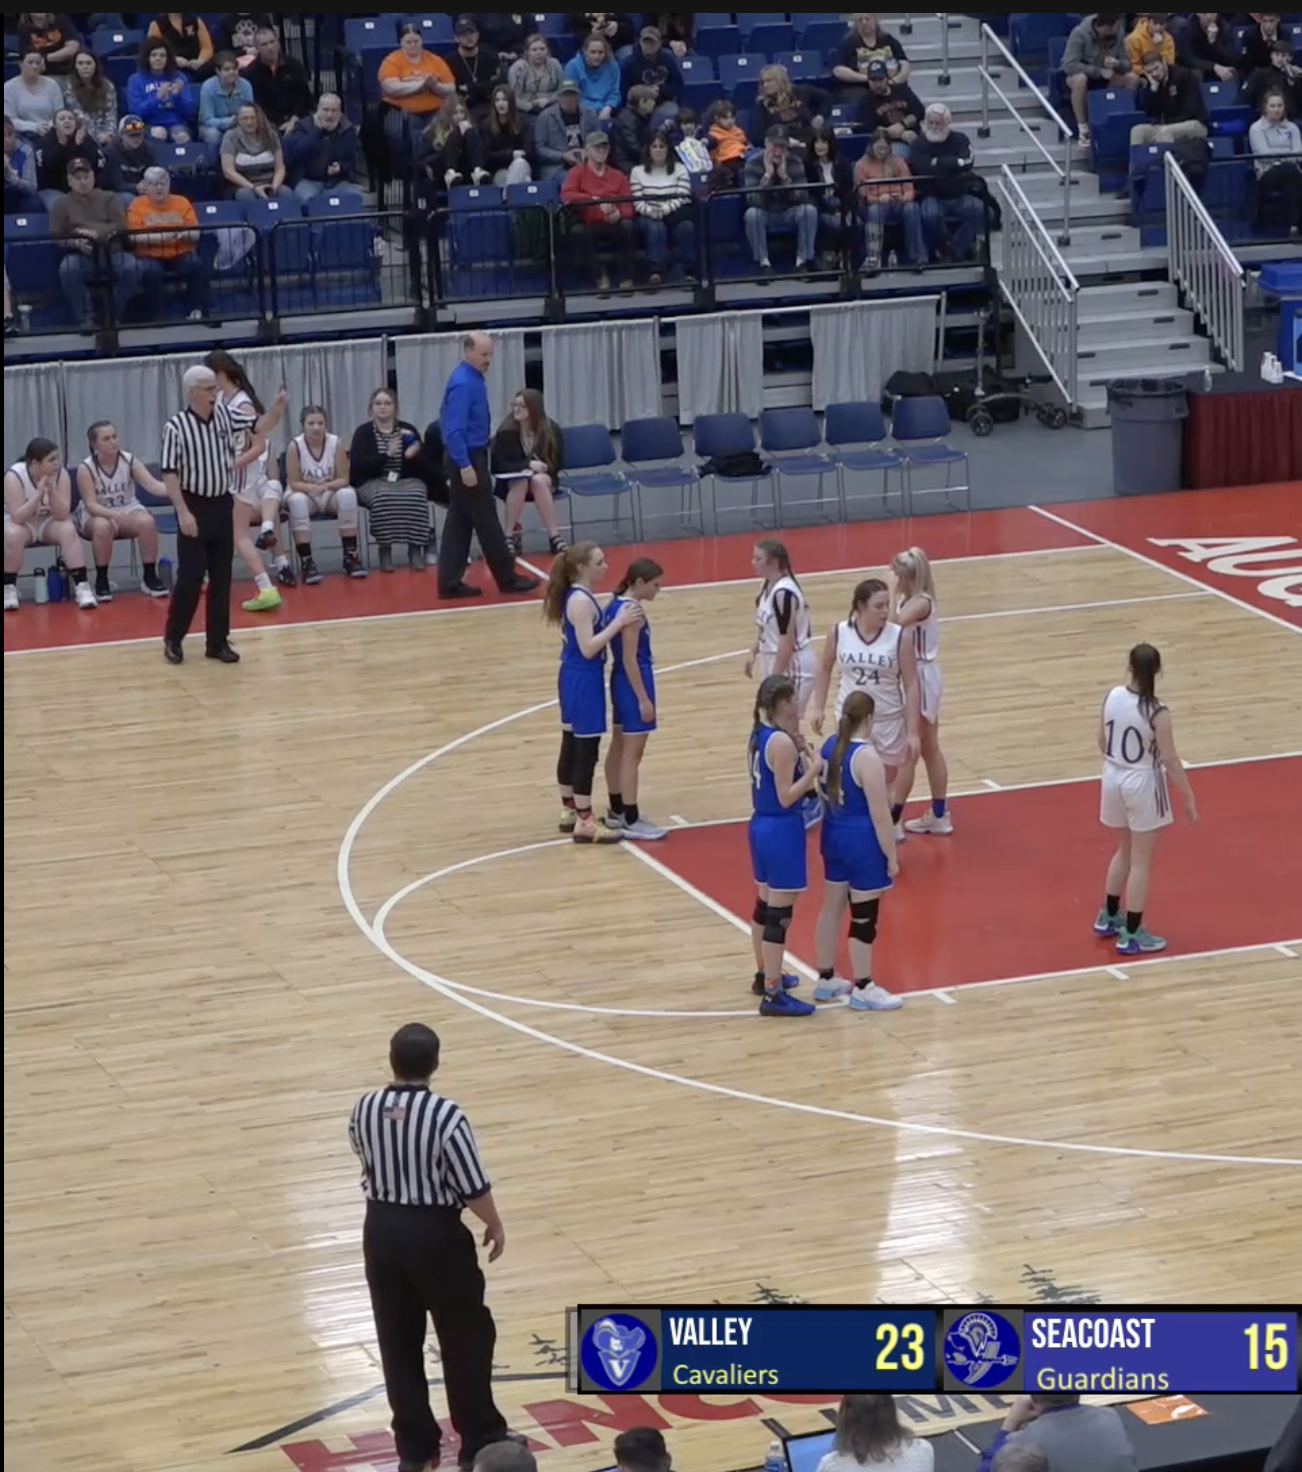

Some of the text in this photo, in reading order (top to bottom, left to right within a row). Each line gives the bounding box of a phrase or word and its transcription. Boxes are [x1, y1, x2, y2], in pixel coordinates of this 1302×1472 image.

[839, 653, 896, 669] VALLEY
[852, 666, 881, 686] 24
[1105, 719, 1145, 764] 10
